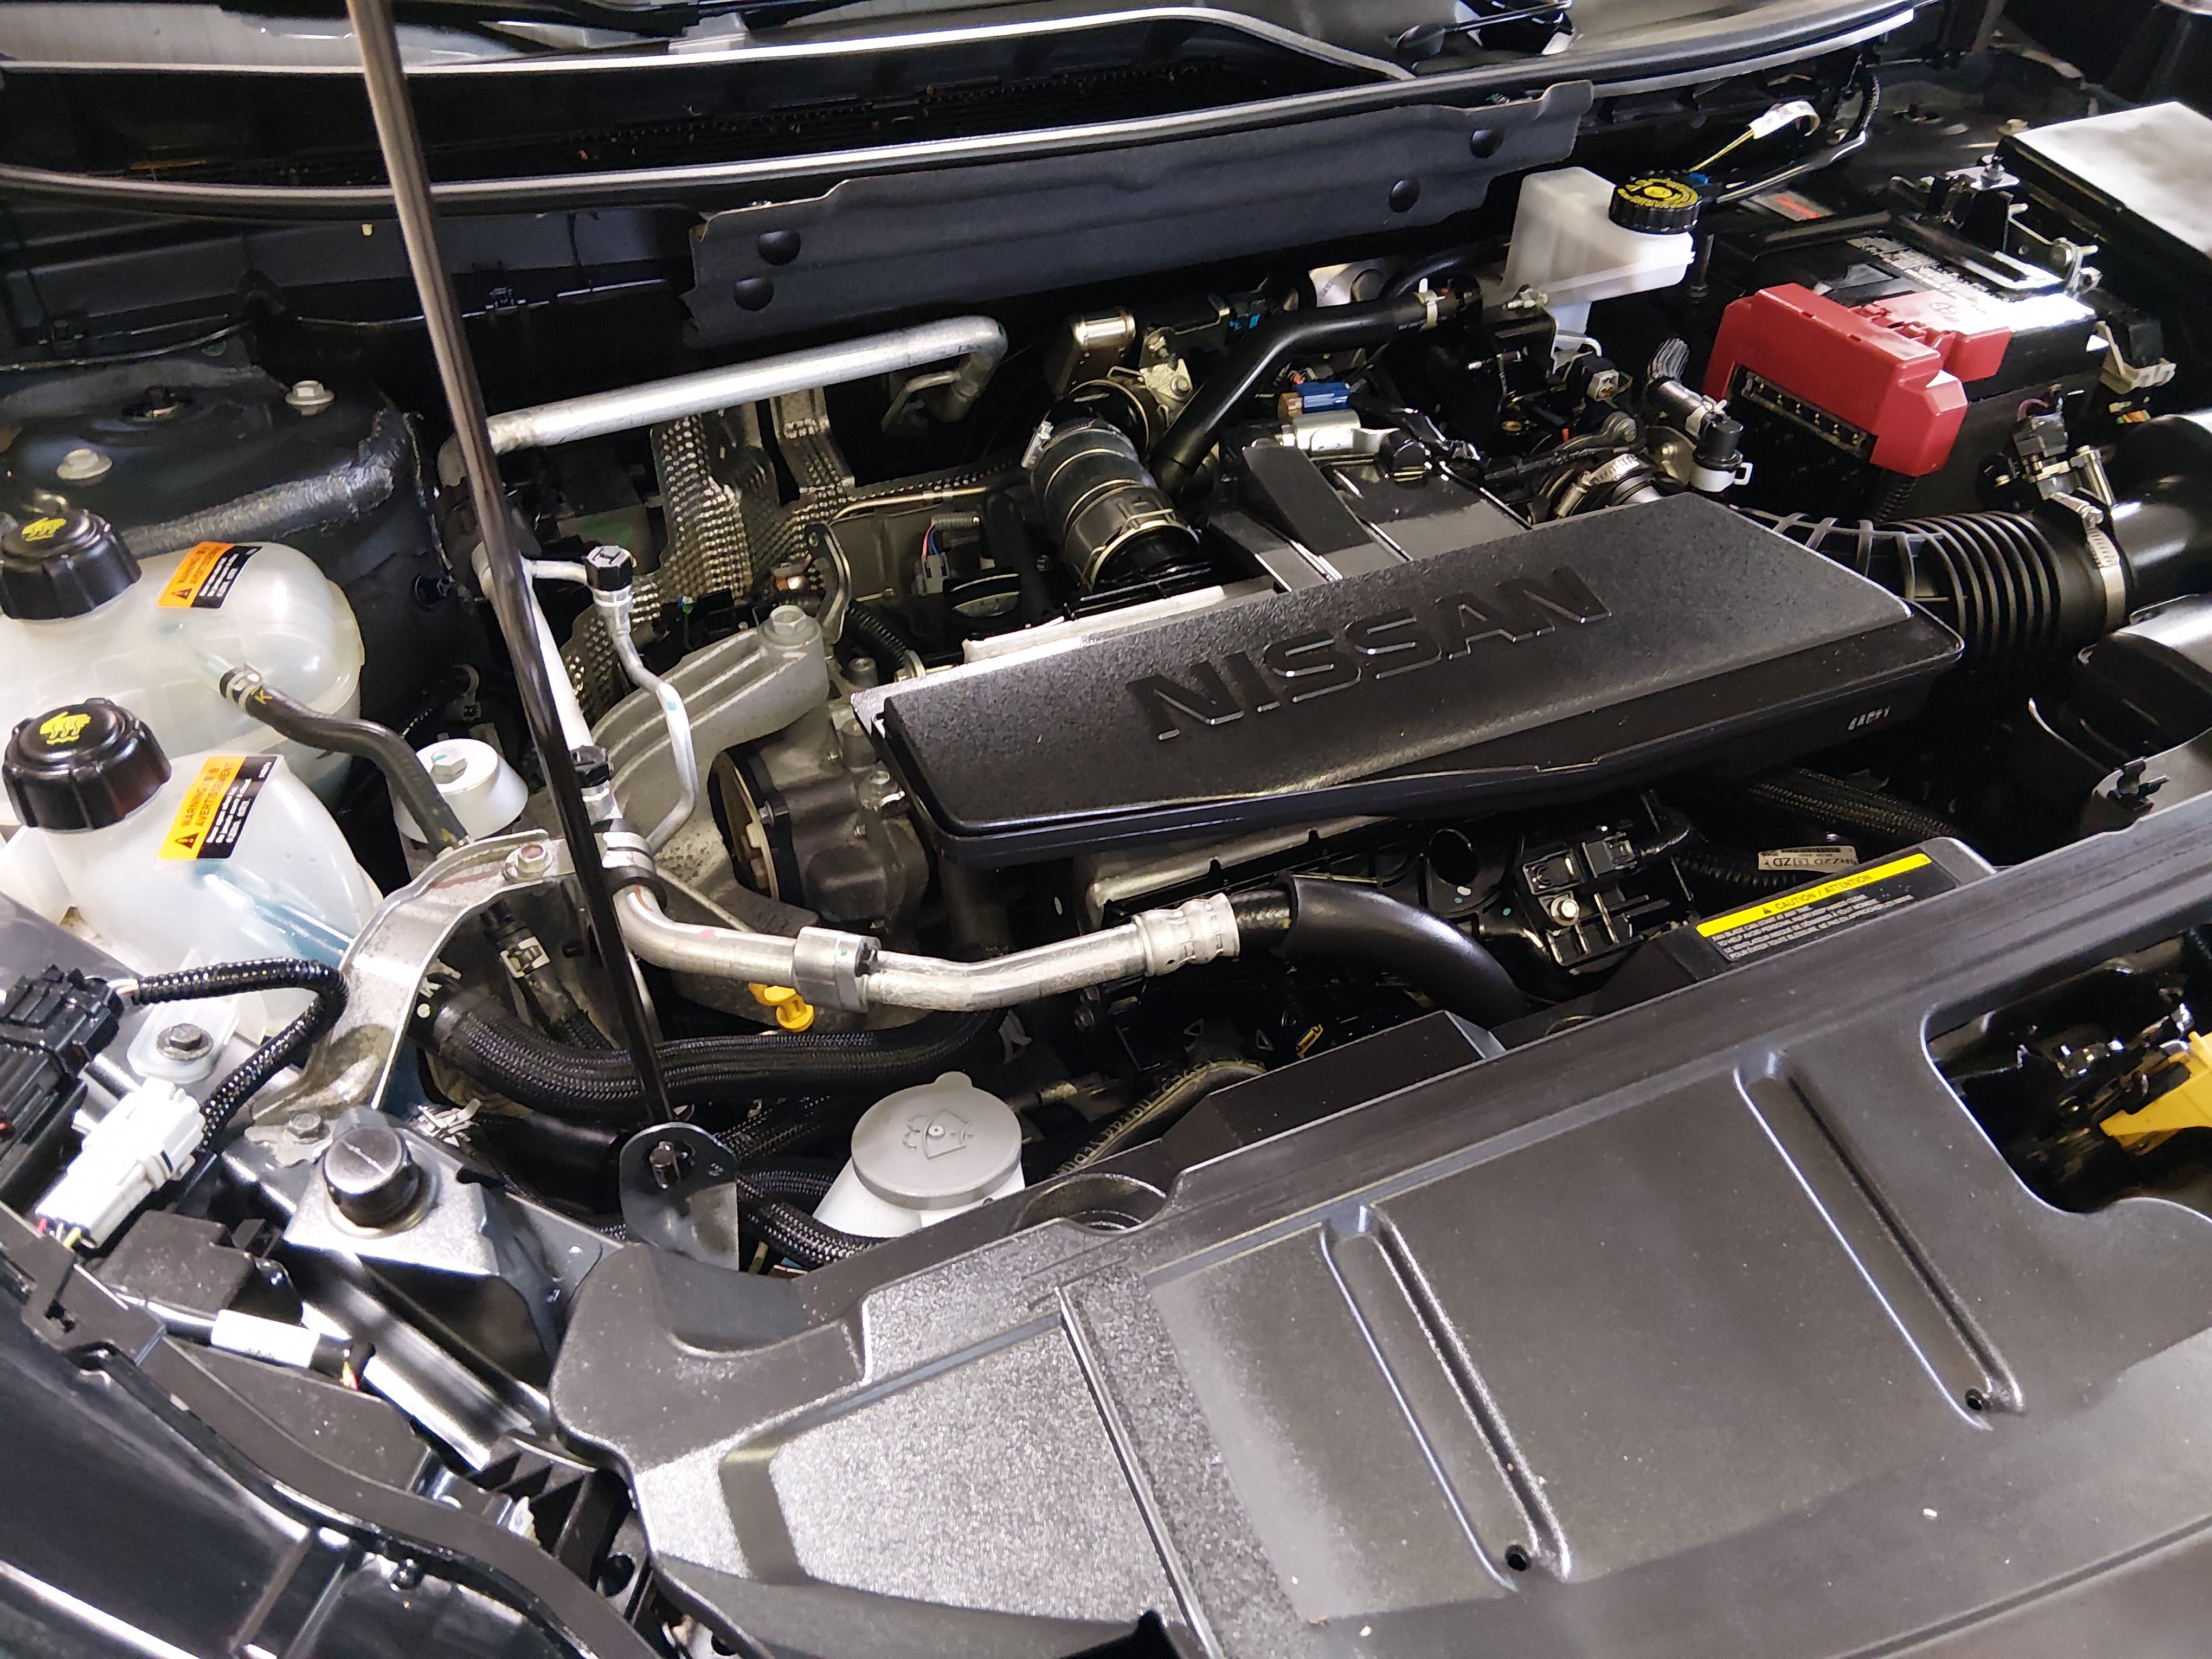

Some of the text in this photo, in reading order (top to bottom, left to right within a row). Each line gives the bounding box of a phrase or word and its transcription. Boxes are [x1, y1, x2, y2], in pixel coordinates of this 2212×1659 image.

[1125, 564, 1613, 741] NISSAN
[1774, 892, 1817, 910] CAUTION
[1825, 873, 1873, 893] ATTENTION
